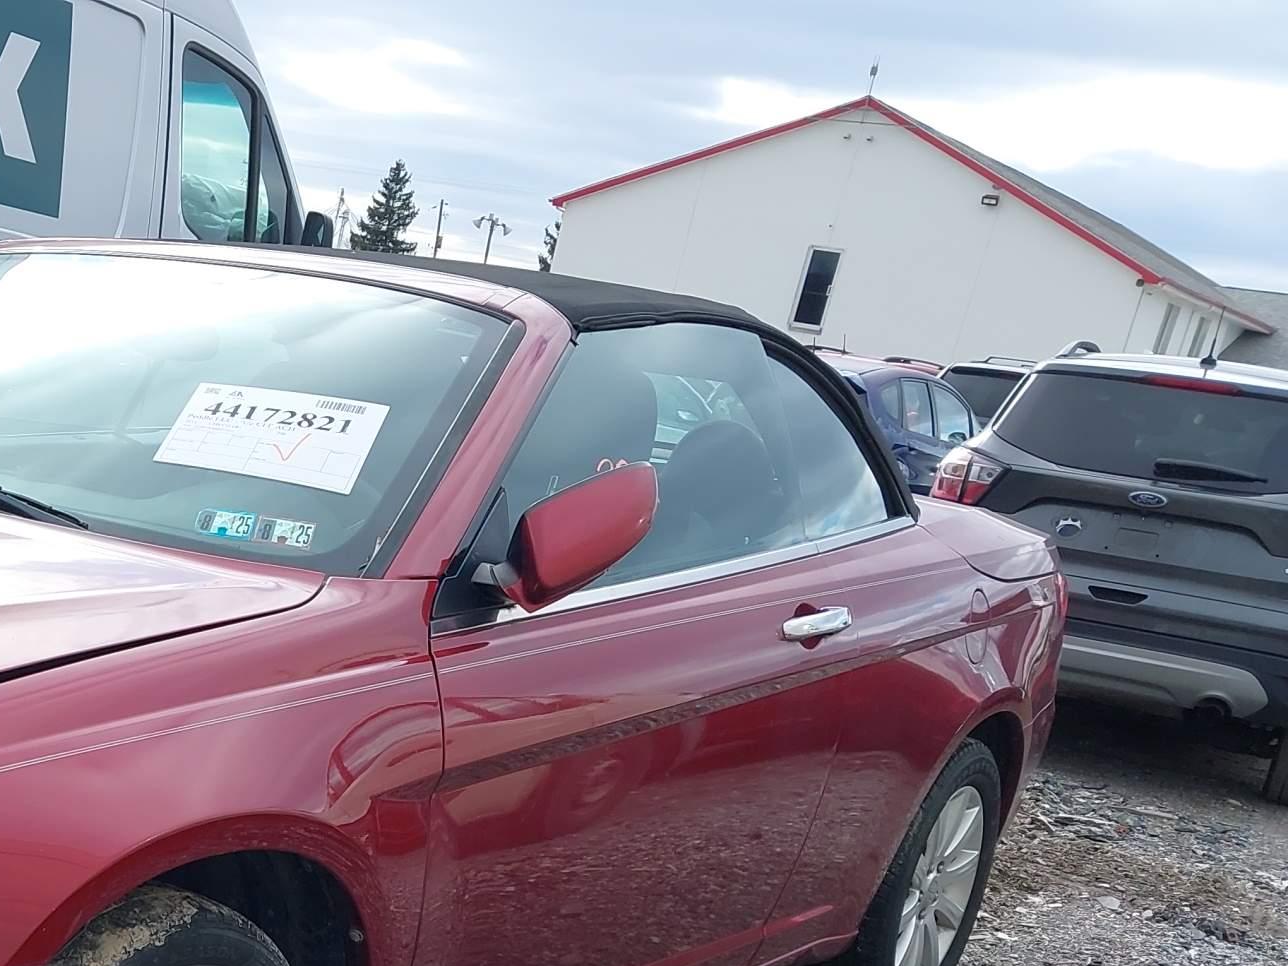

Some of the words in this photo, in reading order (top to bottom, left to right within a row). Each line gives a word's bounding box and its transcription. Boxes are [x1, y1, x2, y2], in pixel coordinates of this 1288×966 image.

[204, 401, 353, 434] 44172821
[235, 515, 253, 535] 25
[295, 524, 313, 545] 25
